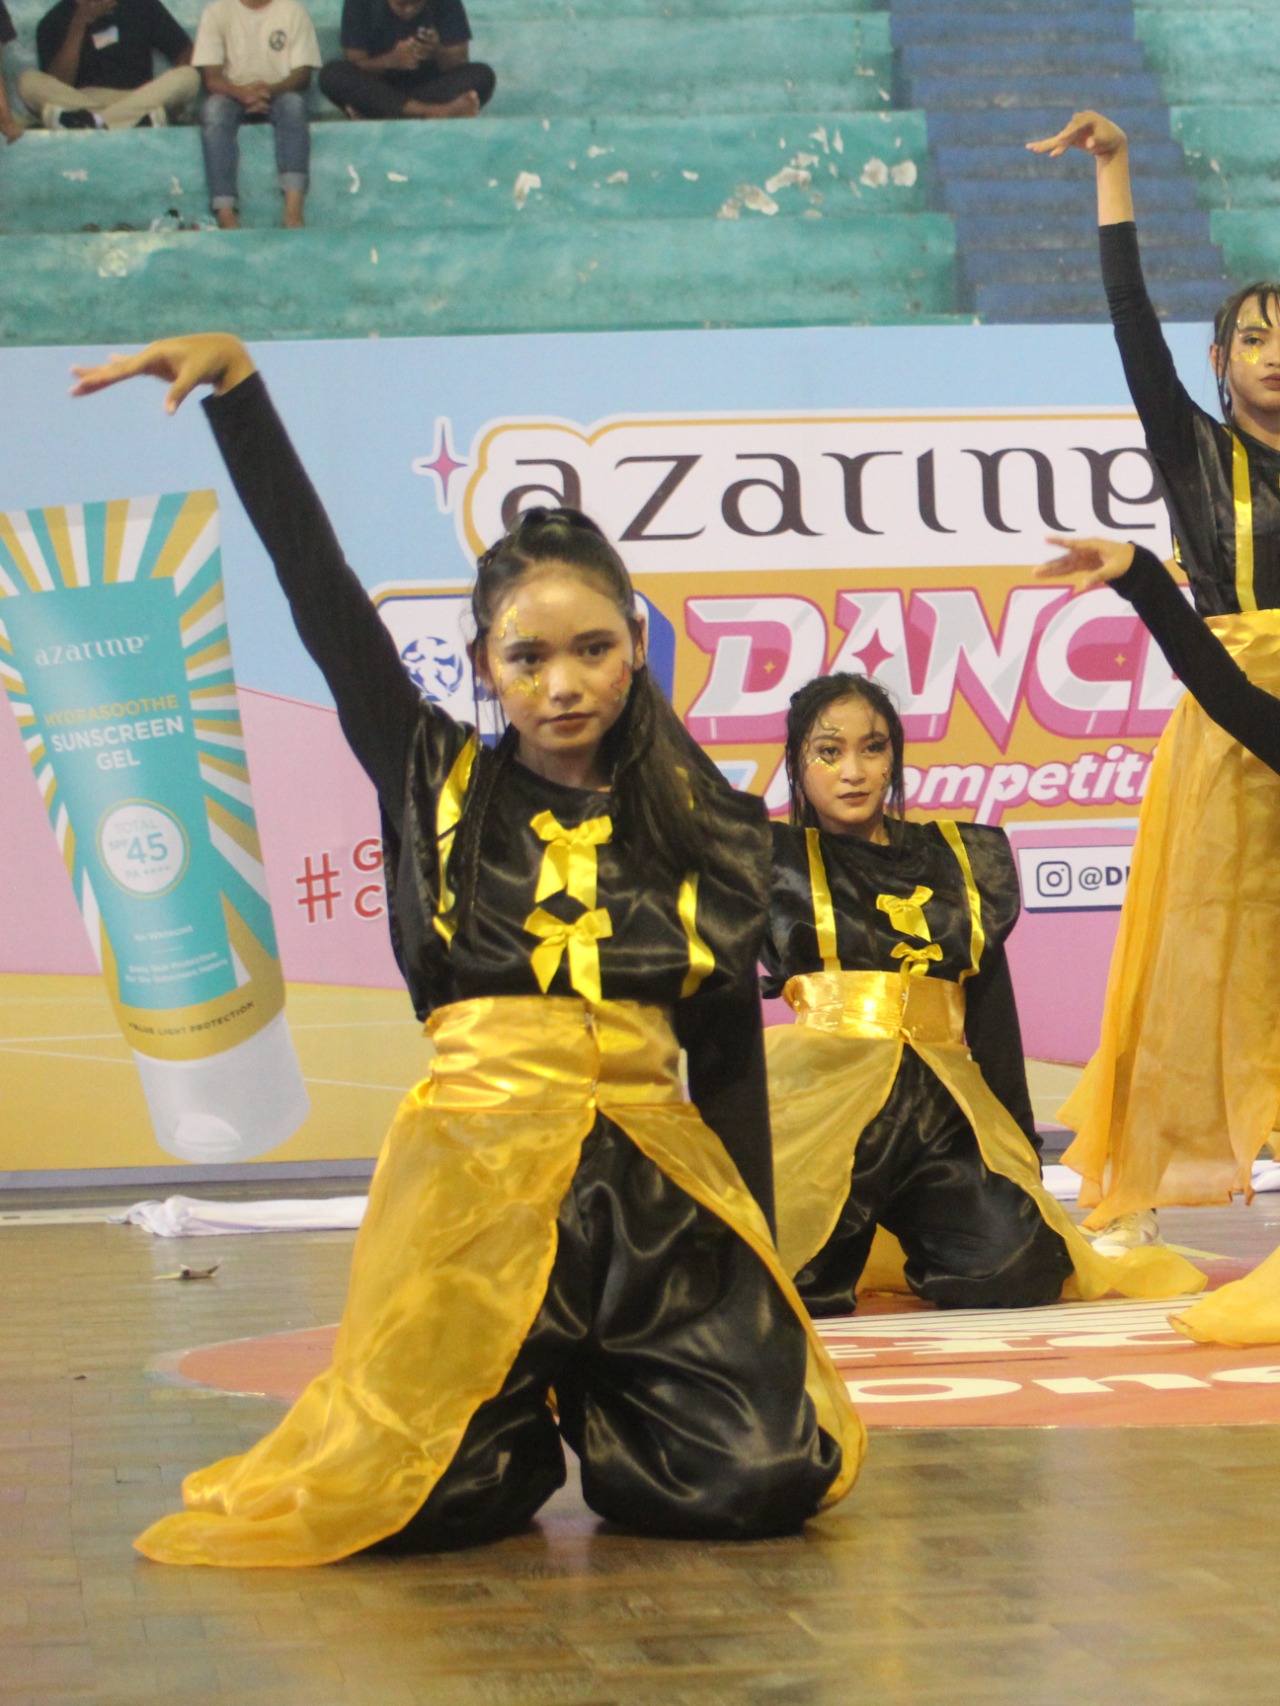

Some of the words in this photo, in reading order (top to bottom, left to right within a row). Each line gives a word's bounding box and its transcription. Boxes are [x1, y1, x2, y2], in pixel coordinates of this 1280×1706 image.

[51, 716, 184, 752] SUNSCREEN
[96, 749, 141, 771] GEL
[127, 832, 168, 864] 45
